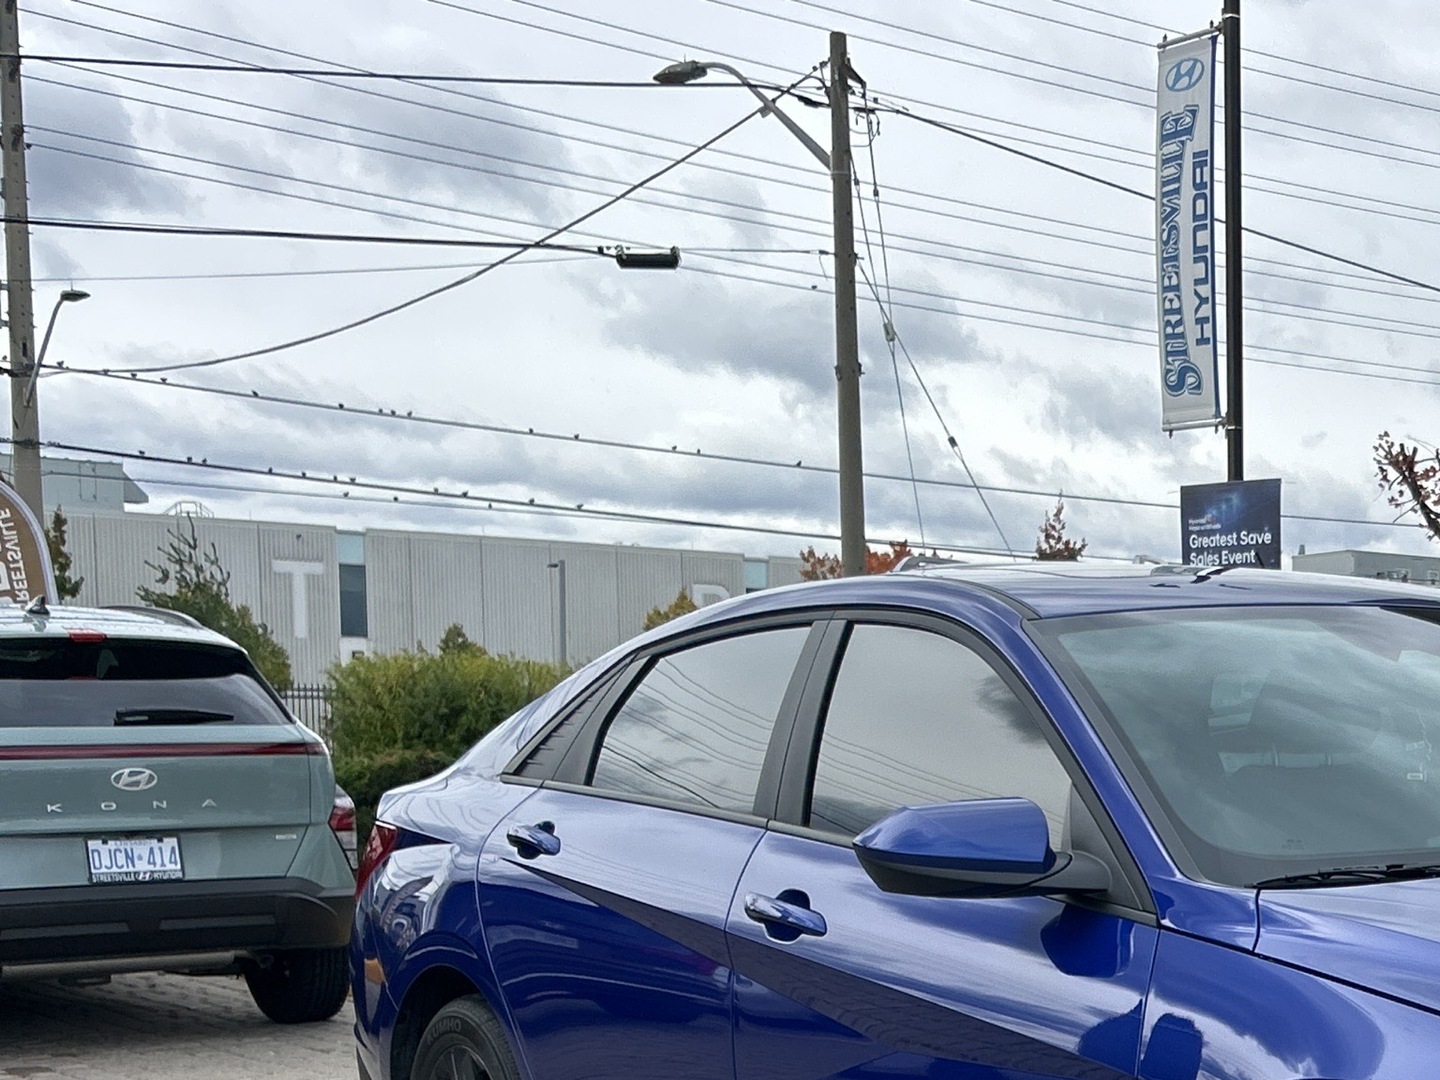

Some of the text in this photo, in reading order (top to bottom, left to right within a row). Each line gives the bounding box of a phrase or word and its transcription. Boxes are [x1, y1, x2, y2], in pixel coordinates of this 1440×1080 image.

[1160, 103, 1203, 396] STREETSVILLE
[1192, 149, 1210, 347] HYUNDAI
[1189, 530, 1272, 548] Greatest Save
[1189, 549, 1256, 566] Sales Event
[46, 798, 218, 813] KONA
[91, 845, 178, 871] DJCN 414
[92, 871, 136, 882] STREETSVILLE
